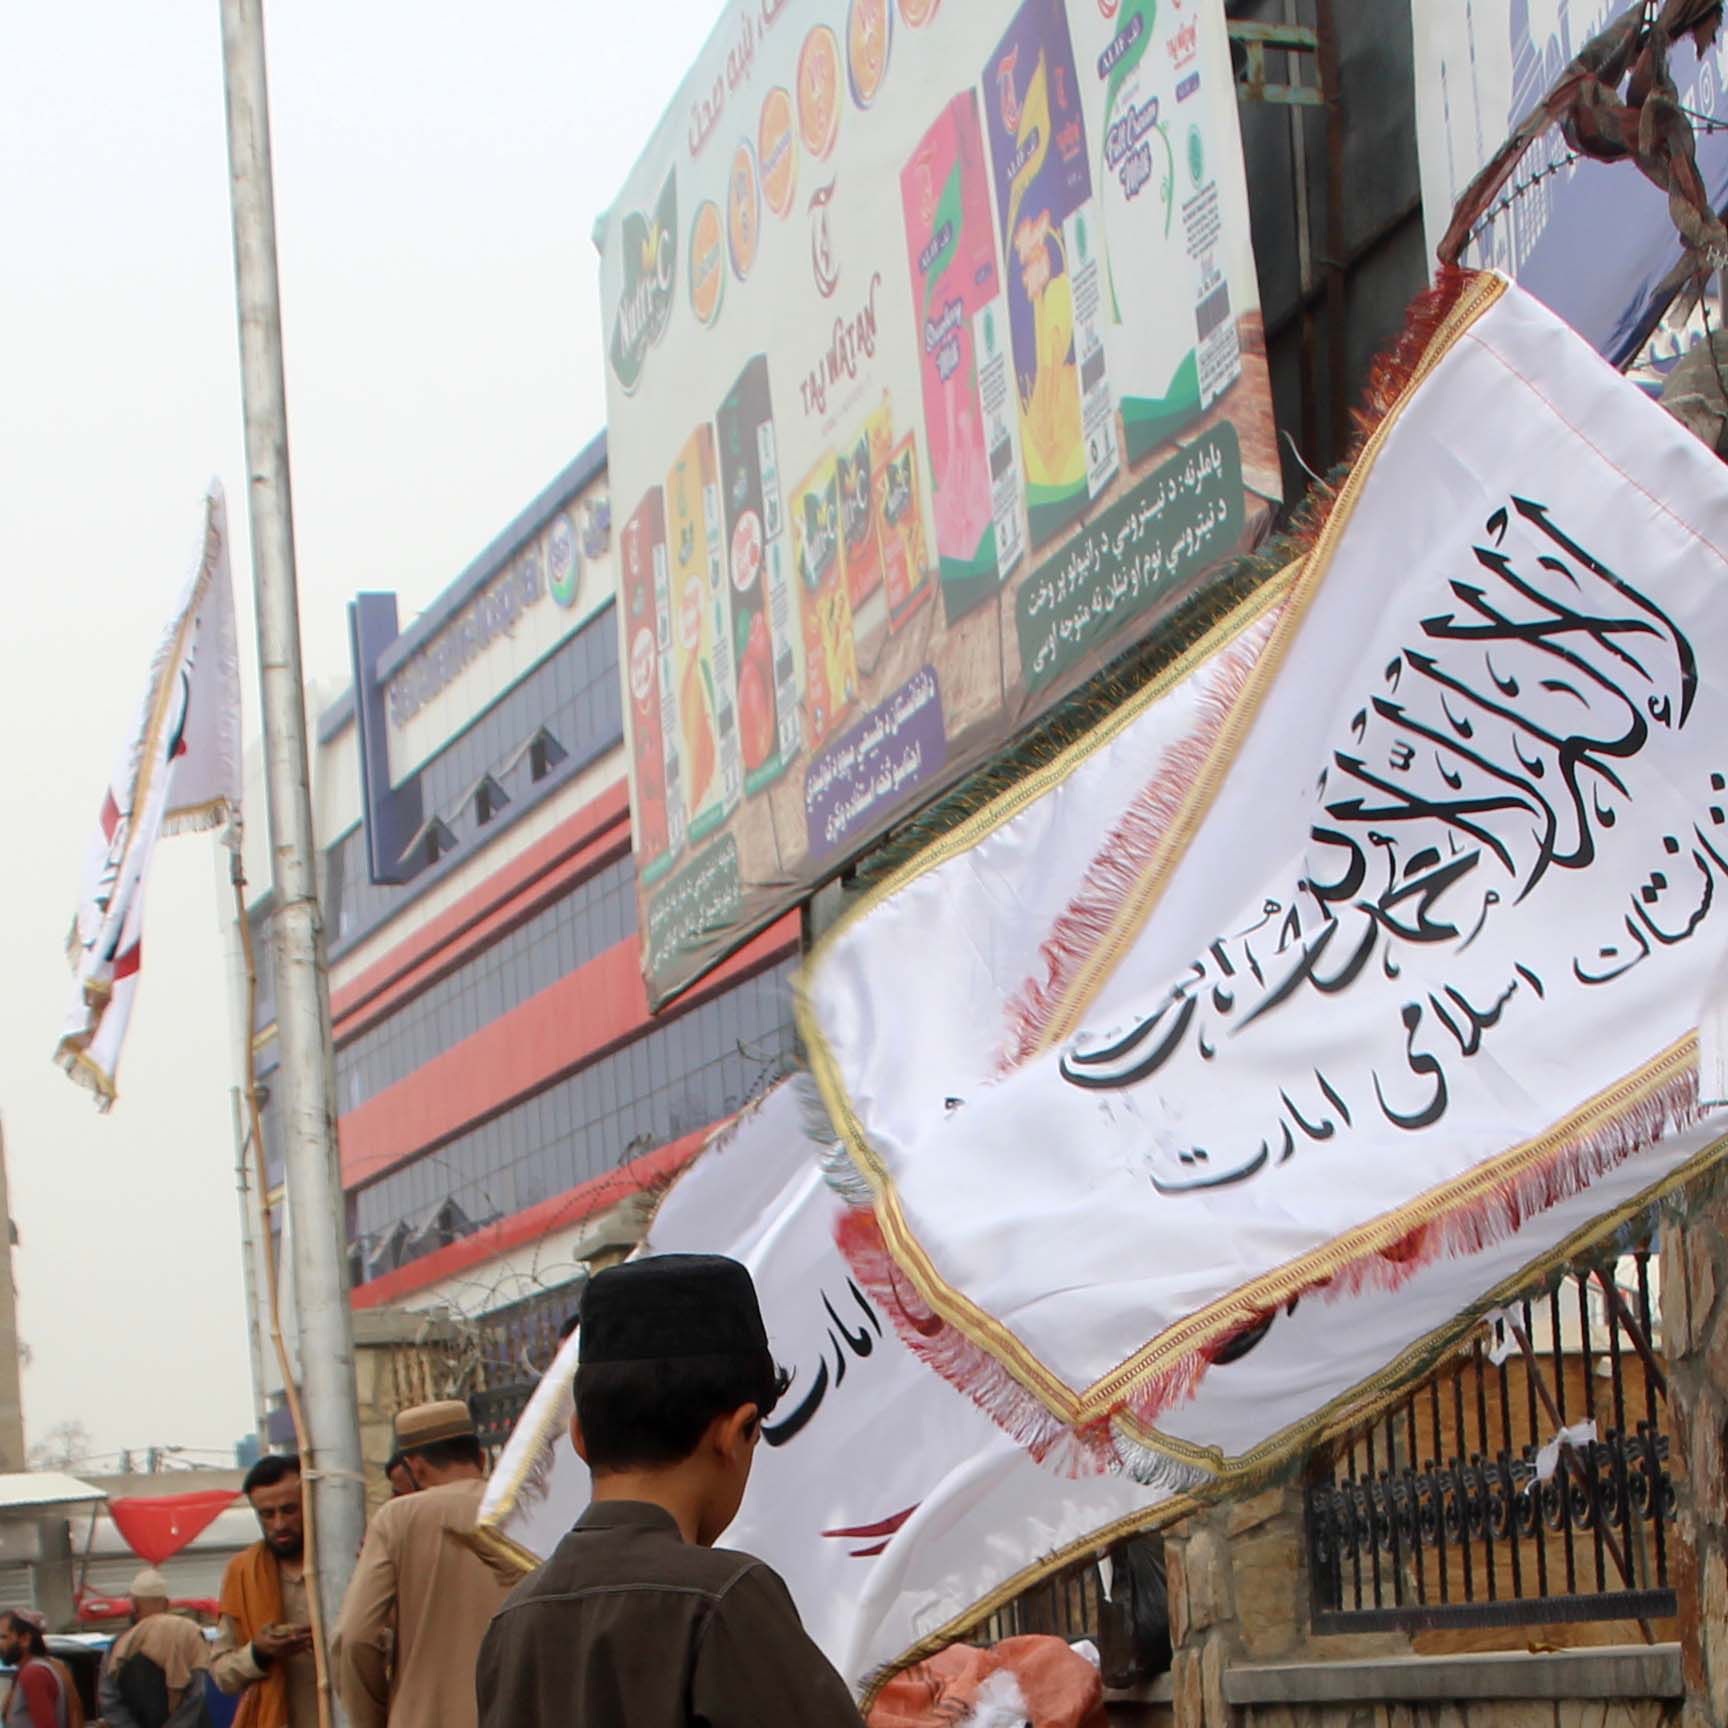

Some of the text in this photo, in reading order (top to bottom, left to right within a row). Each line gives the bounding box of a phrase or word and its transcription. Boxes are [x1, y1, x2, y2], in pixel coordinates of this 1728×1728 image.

[800, 271, 881, 416] TAJ WATAN
[1149, 1066, 1353, 1196] امارت
